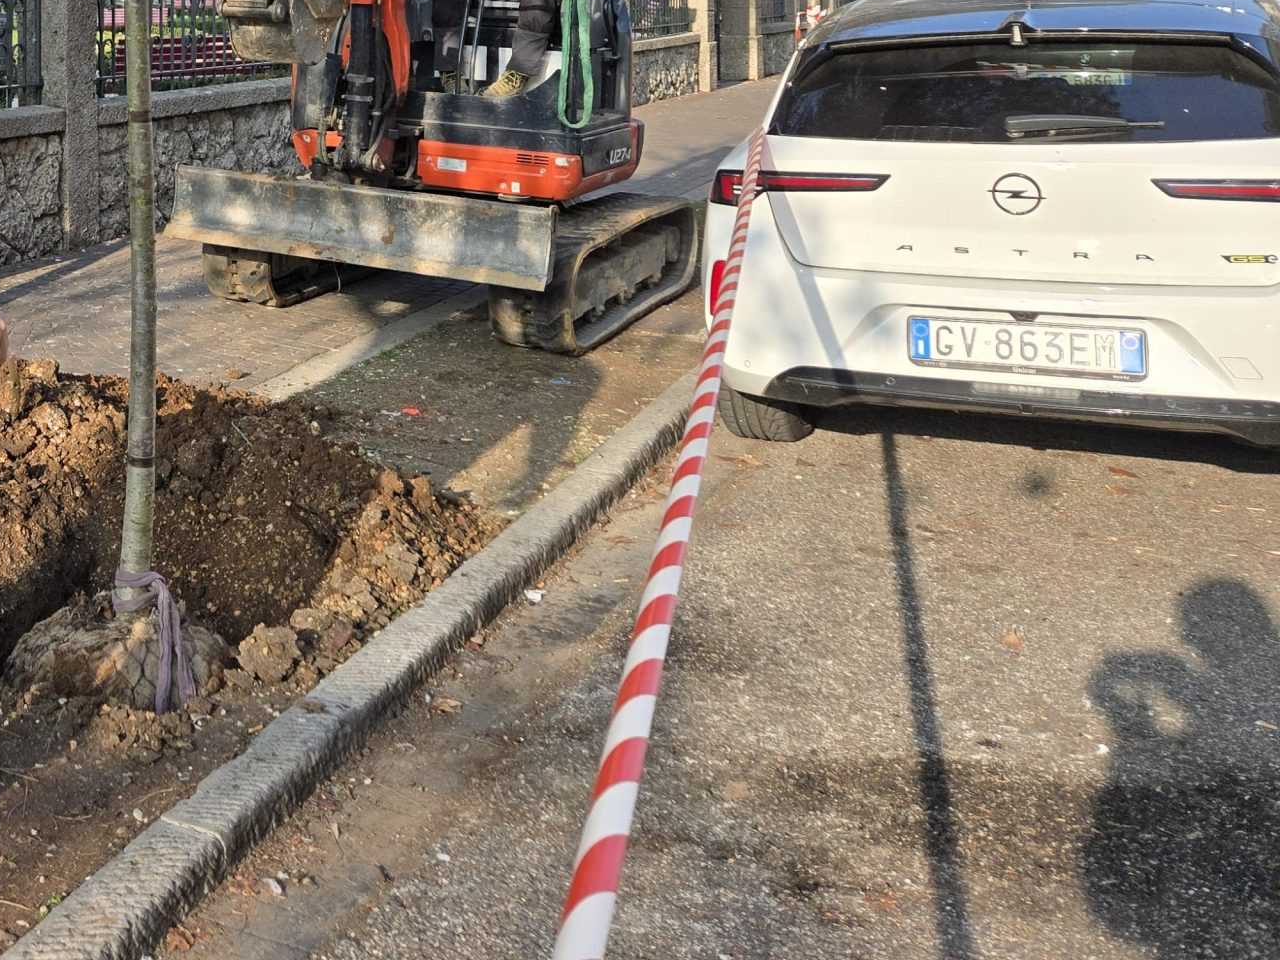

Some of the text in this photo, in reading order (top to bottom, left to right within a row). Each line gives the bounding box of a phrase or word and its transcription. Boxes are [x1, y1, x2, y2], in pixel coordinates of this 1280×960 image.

[896, 244, 1154, 262] ASTRA
[935, 325, 977, 358] GV
[995, 328, 1117, 369] 863EM
